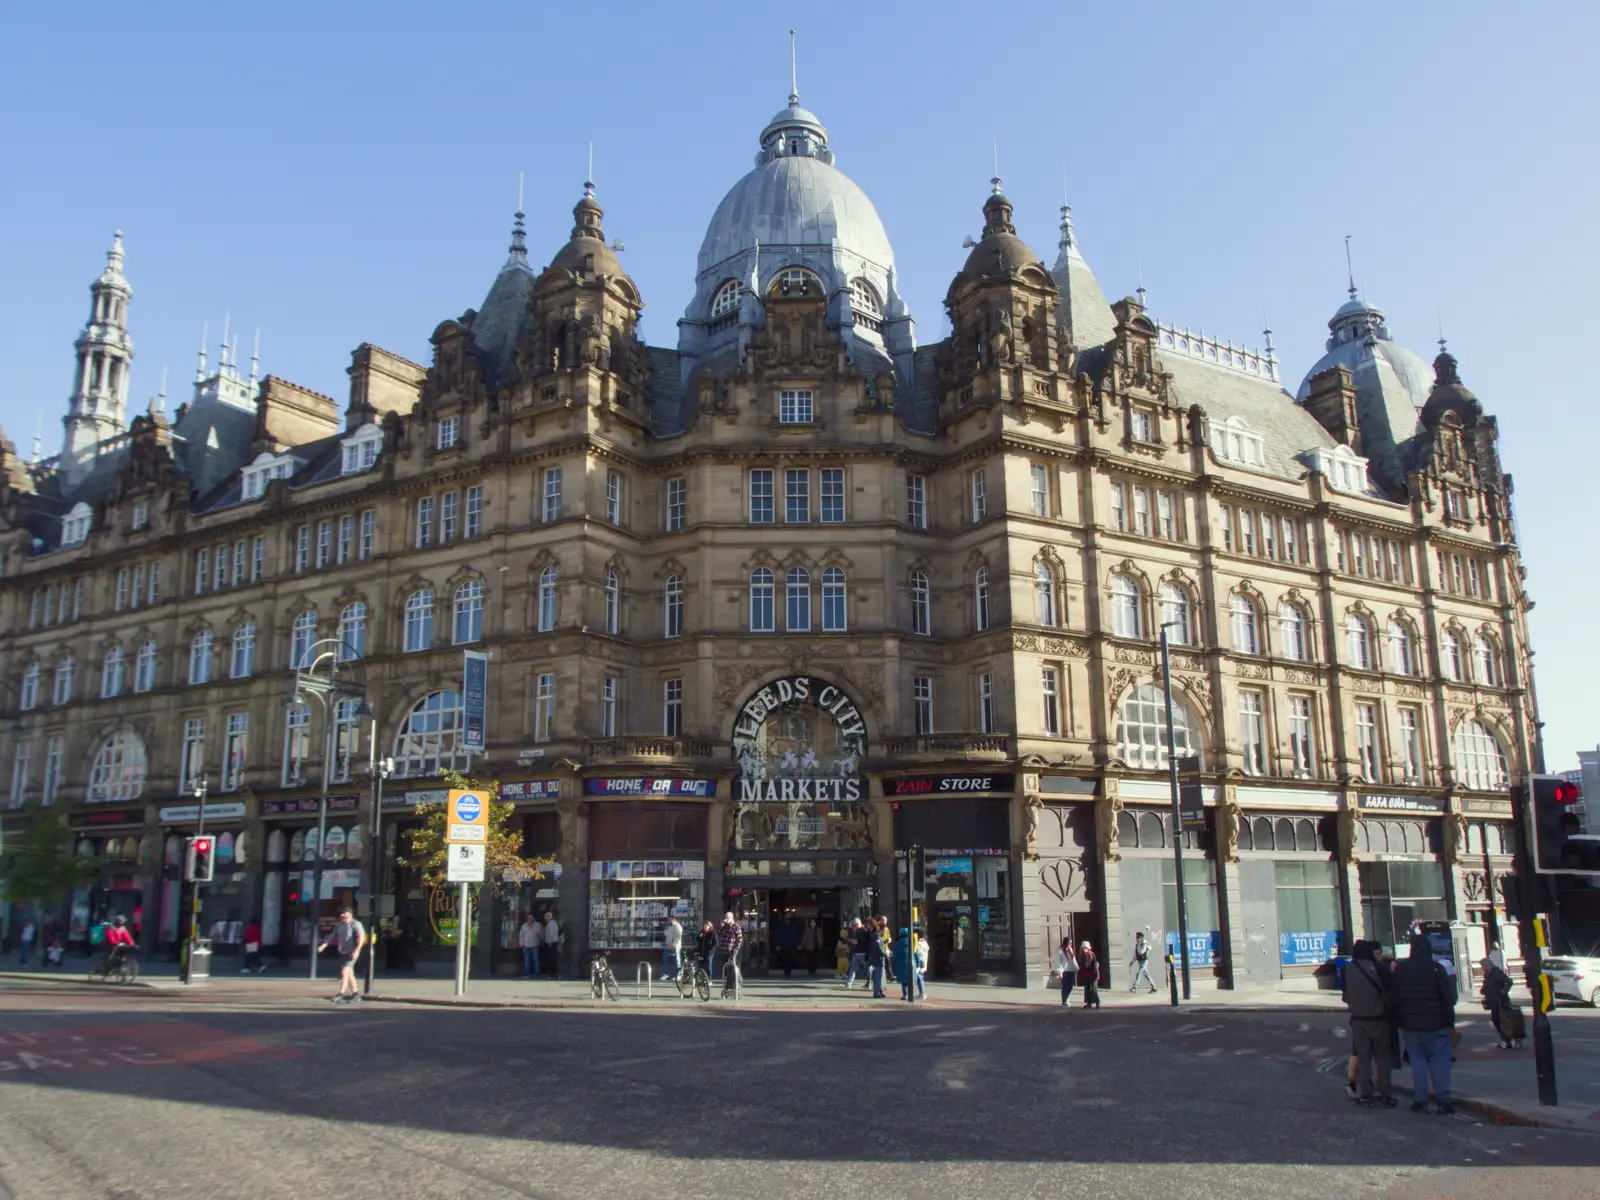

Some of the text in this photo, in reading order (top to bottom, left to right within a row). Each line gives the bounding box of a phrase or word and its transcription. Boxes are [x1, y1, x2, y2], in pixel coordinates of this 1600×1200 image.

[735, 678, 865, 738] LEEDS CITY
[599, 779, 697, 791] PHONE FOR YOU
[740, 778, 860, 801] MARKETS
[895, 777, 992, 793] ZAIN STORE
[434, 889, 478, 912] Rue
[1192, 938, 1207, 951] LET
[1294, 938, 1324, 951] TO LET
